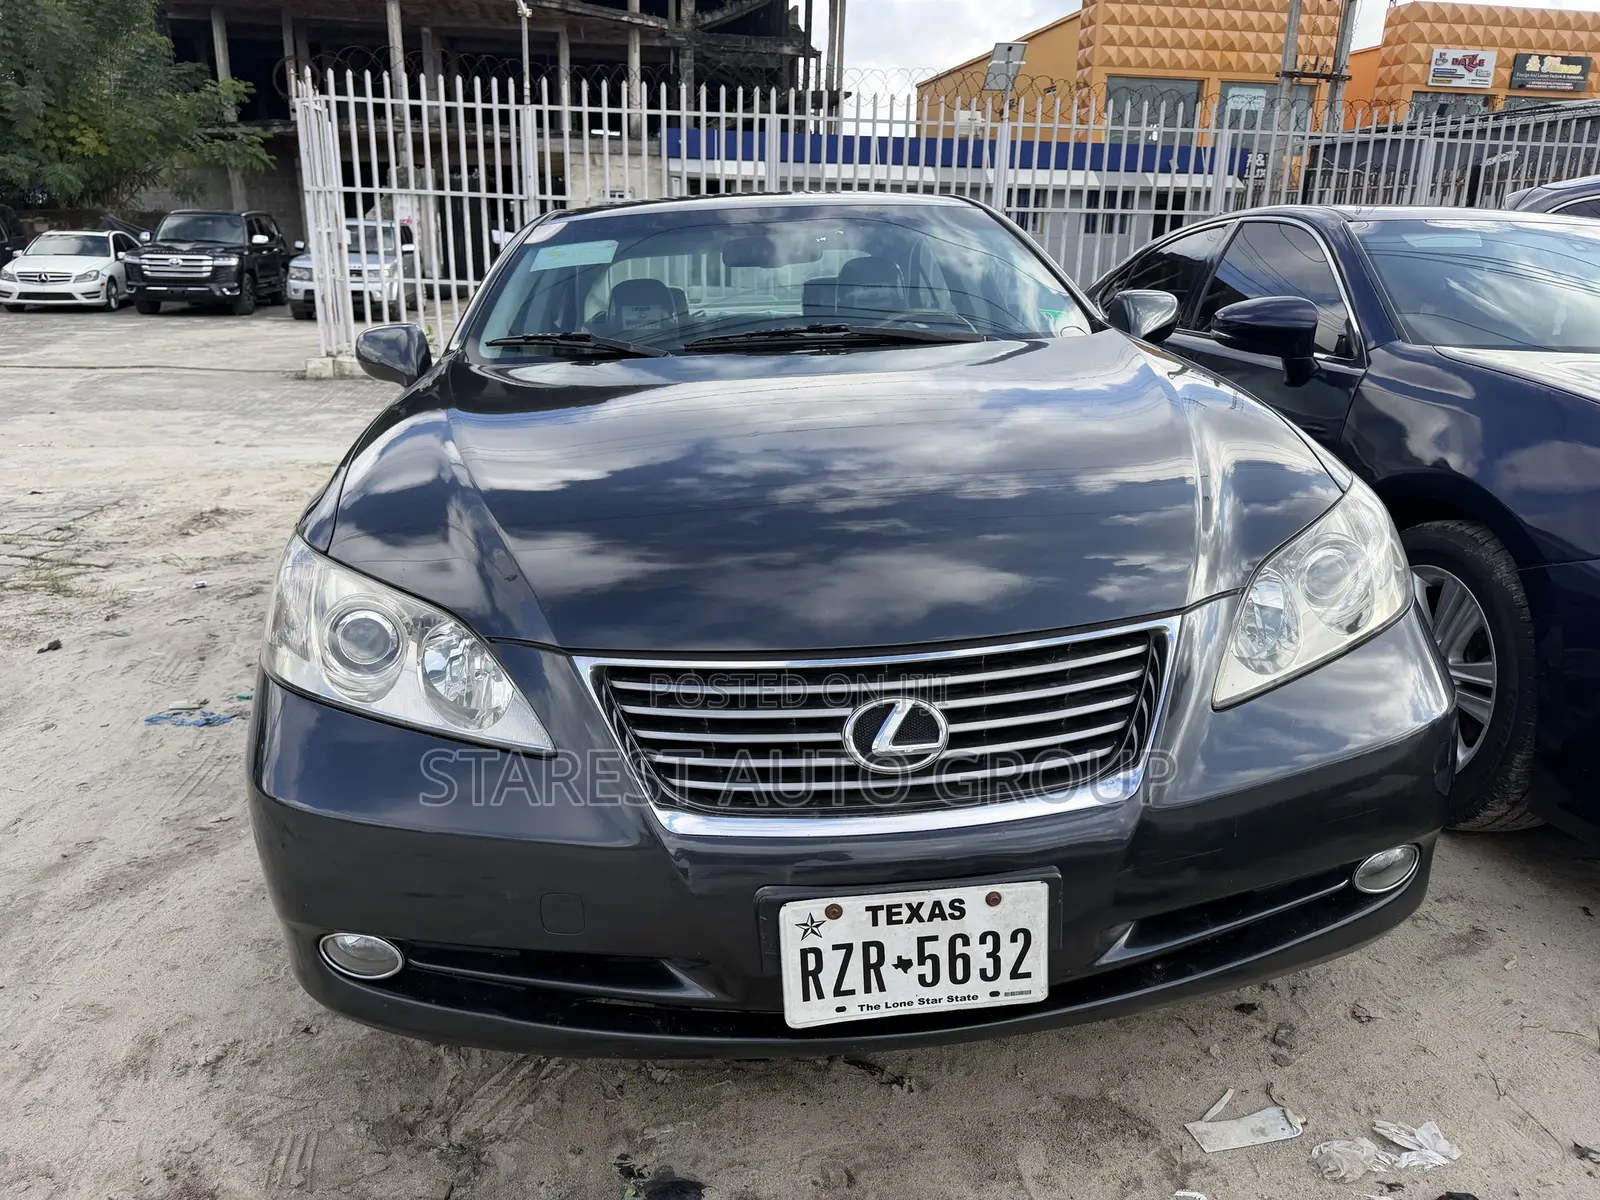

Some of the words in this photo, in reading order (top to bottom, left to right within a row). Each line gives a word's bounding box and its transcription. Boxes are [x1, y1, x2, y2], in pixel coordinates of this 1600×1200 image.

[865, 898, 967, 927] TEXAS
[799, 940, 887, 1003] RZR
[916, 927, 1032, 988] 5632
[858, 1004, 881, 1012] The
[884, 999, 914, 1009] Lone
[917, 995, 943, 1006] Star
[946, 993, 979, 1003] State
